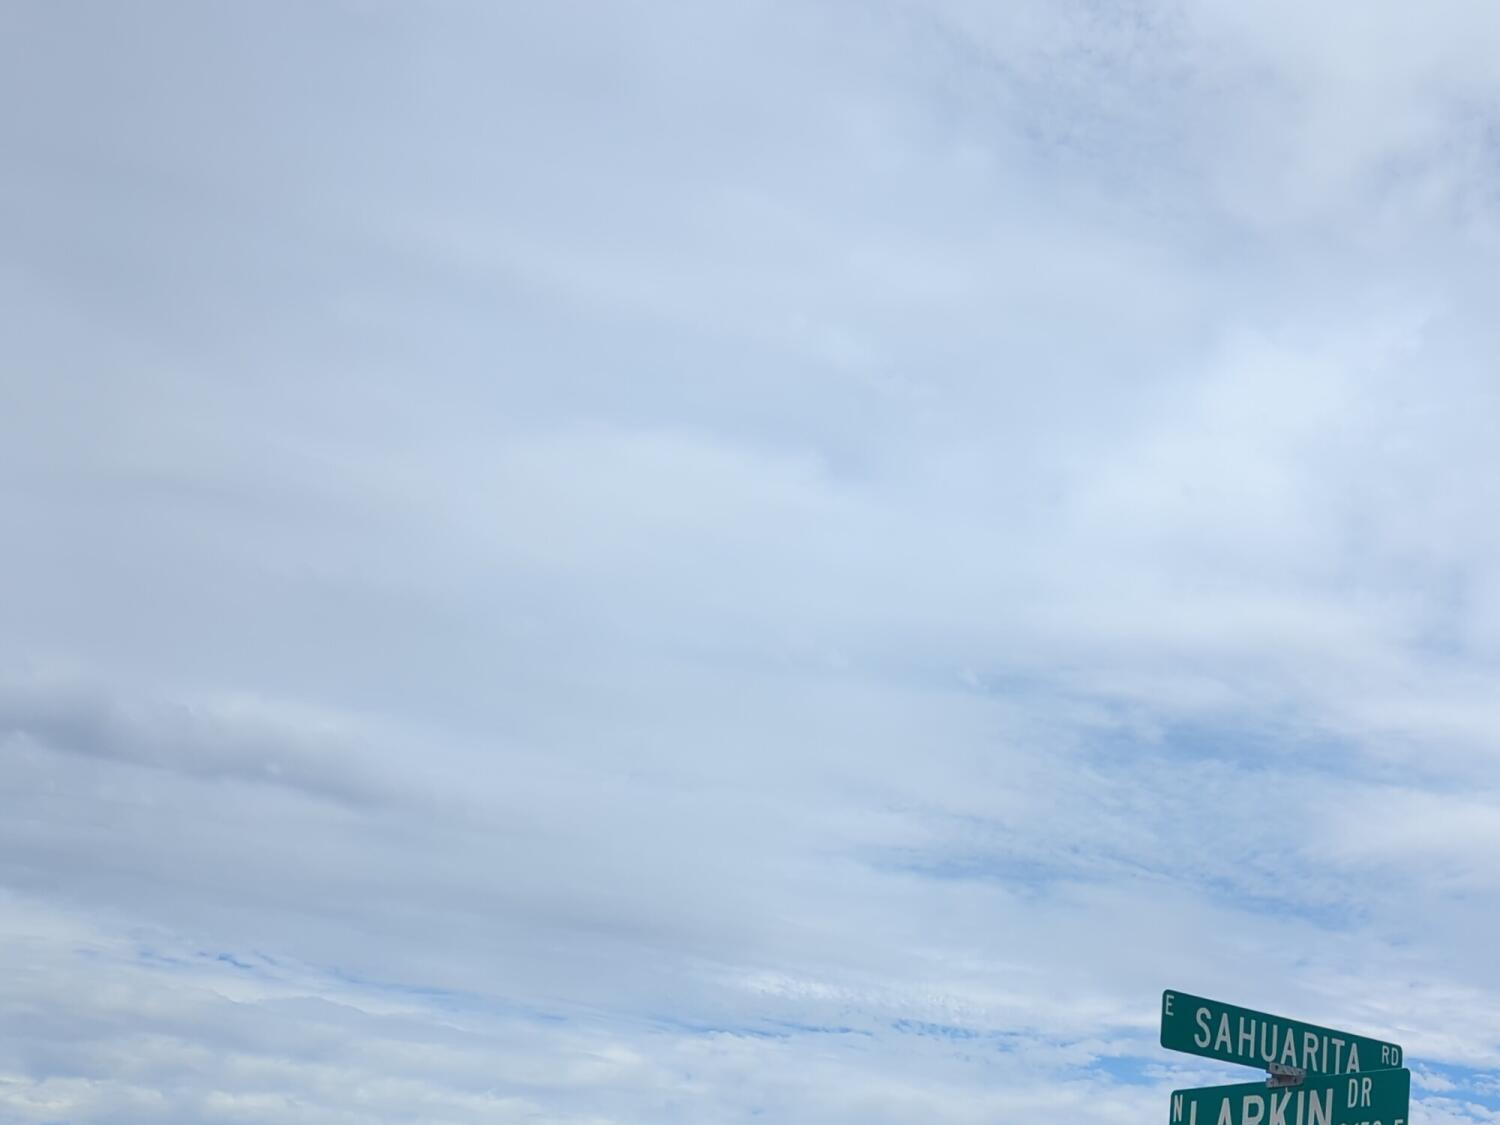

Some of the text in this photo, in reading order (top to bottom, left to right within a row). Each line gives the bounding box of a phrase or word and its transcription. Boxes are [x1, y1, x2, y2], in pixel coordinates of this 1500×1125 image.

[1165, 994, 1399, 1074] E SAHUARITA RD
[1173, 1094, 1184, 1122] N
[1347, 1077, 1373, 1108] DR
